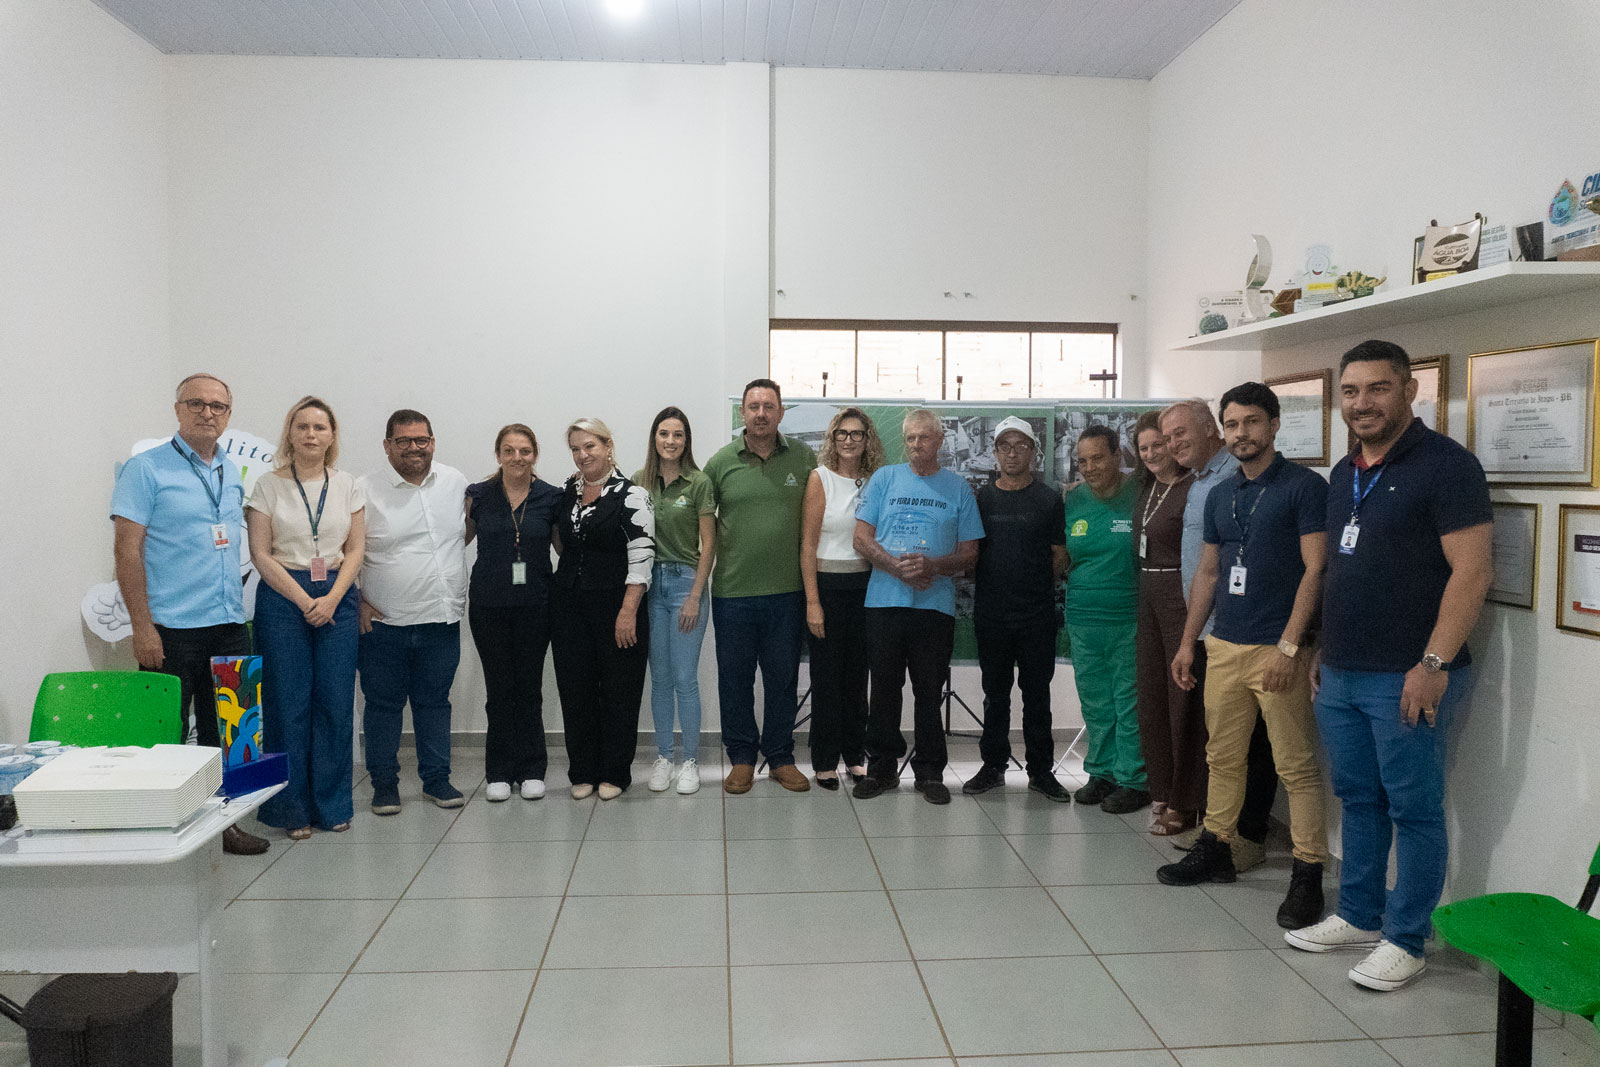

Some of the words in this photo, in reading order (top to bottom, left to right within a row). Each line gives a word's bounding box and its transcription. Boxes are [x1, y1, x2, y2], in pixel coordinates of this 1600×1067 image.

[1455, 246, 1469, 255] BOA
[226, 438, 274, 463] lito
[897, 497, 911, 505] FEIRA
[911, 497, 919, 506] DO
[920, 498, 934, 507] PEIXE
[935, 499, 947, 510] VIVO
